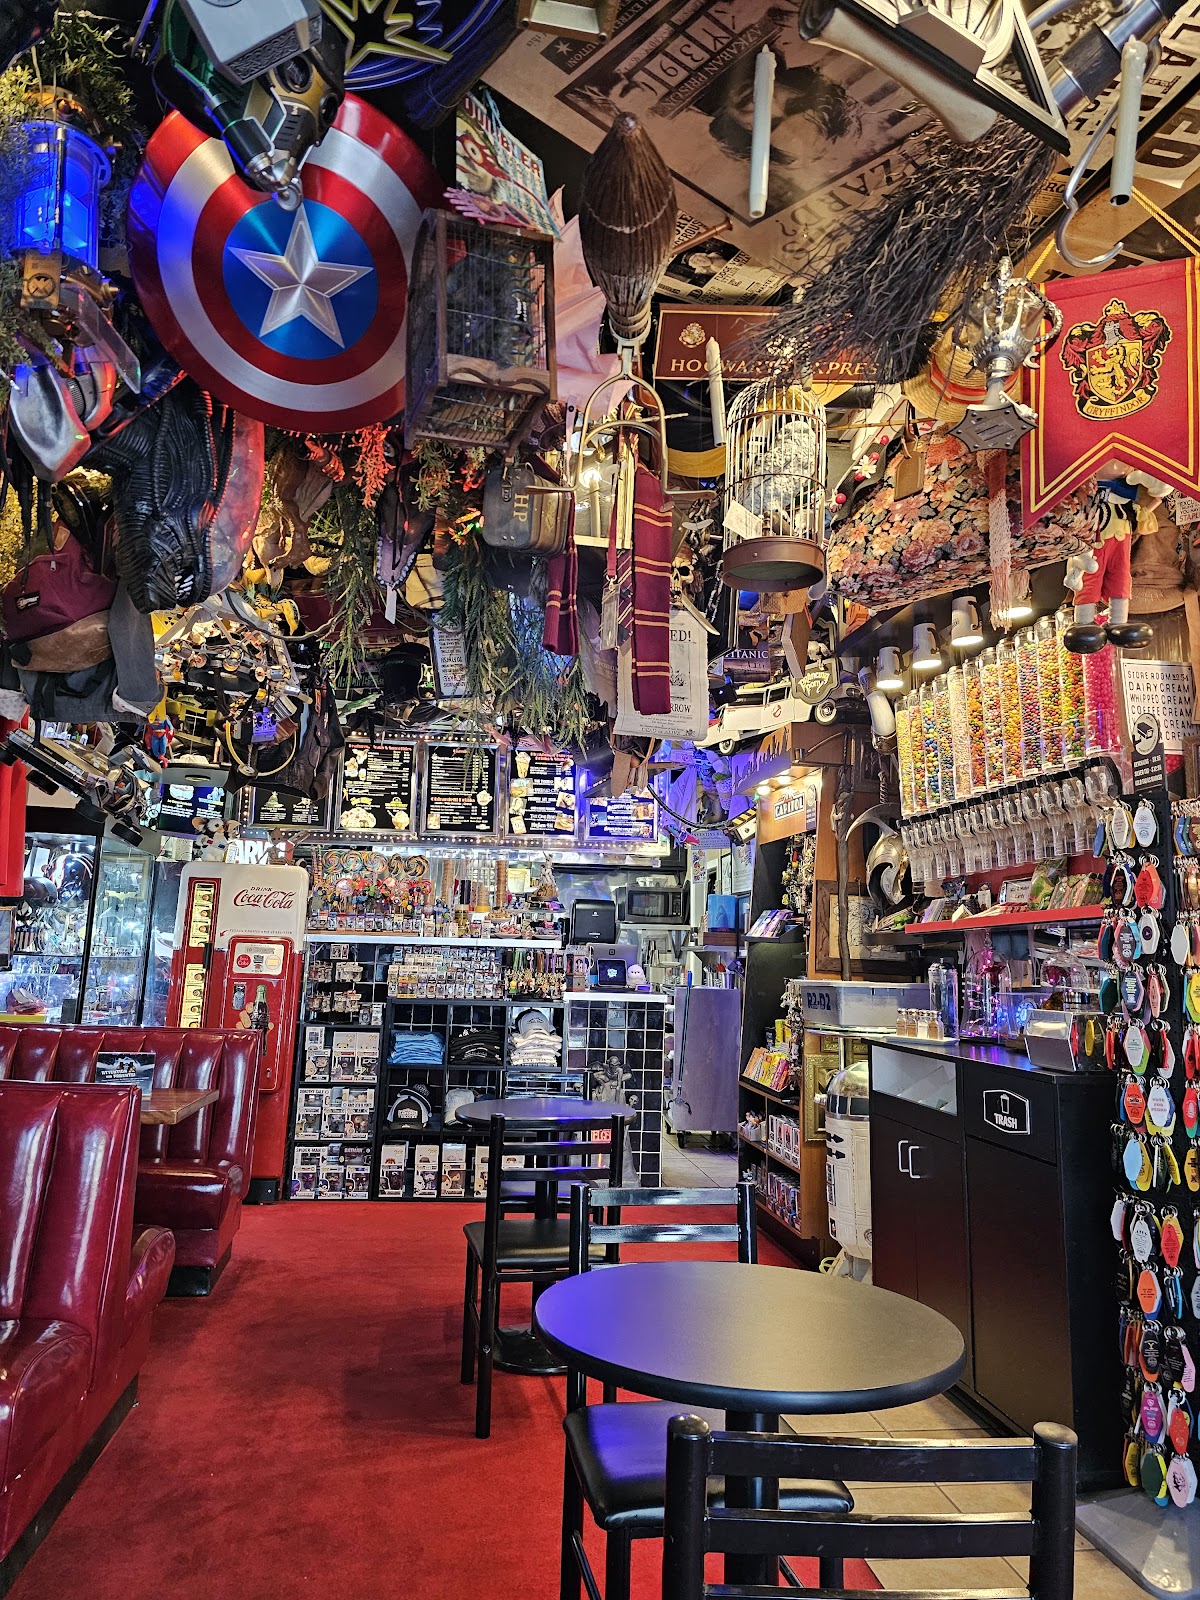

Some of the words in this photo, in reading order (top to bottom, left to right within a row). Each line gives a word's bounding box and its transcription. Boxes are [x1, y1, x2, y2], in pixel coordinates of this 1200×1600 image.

[661, 66, 708, 112] PRISON
[1086, 396, 1147, 417] GRYFFINDOR
[513, 493, 530, 522] HP
[1127, 670, 1148, 680] STORE
[1128, 681, 1158, 693] DAIRY
[1159, 683, 1190, 693] CREAM
[1130, 693, 1160, 704] WHIPPED
[1161, 694, 1191, 705] CREAM
[1162, 706, 1193, 717] CREAM
[775, 796, 804, 816] CAPITOL
[806, 992, 832, 1011] R2-D2
[993, 1112, 1018, 1130] TRASH
